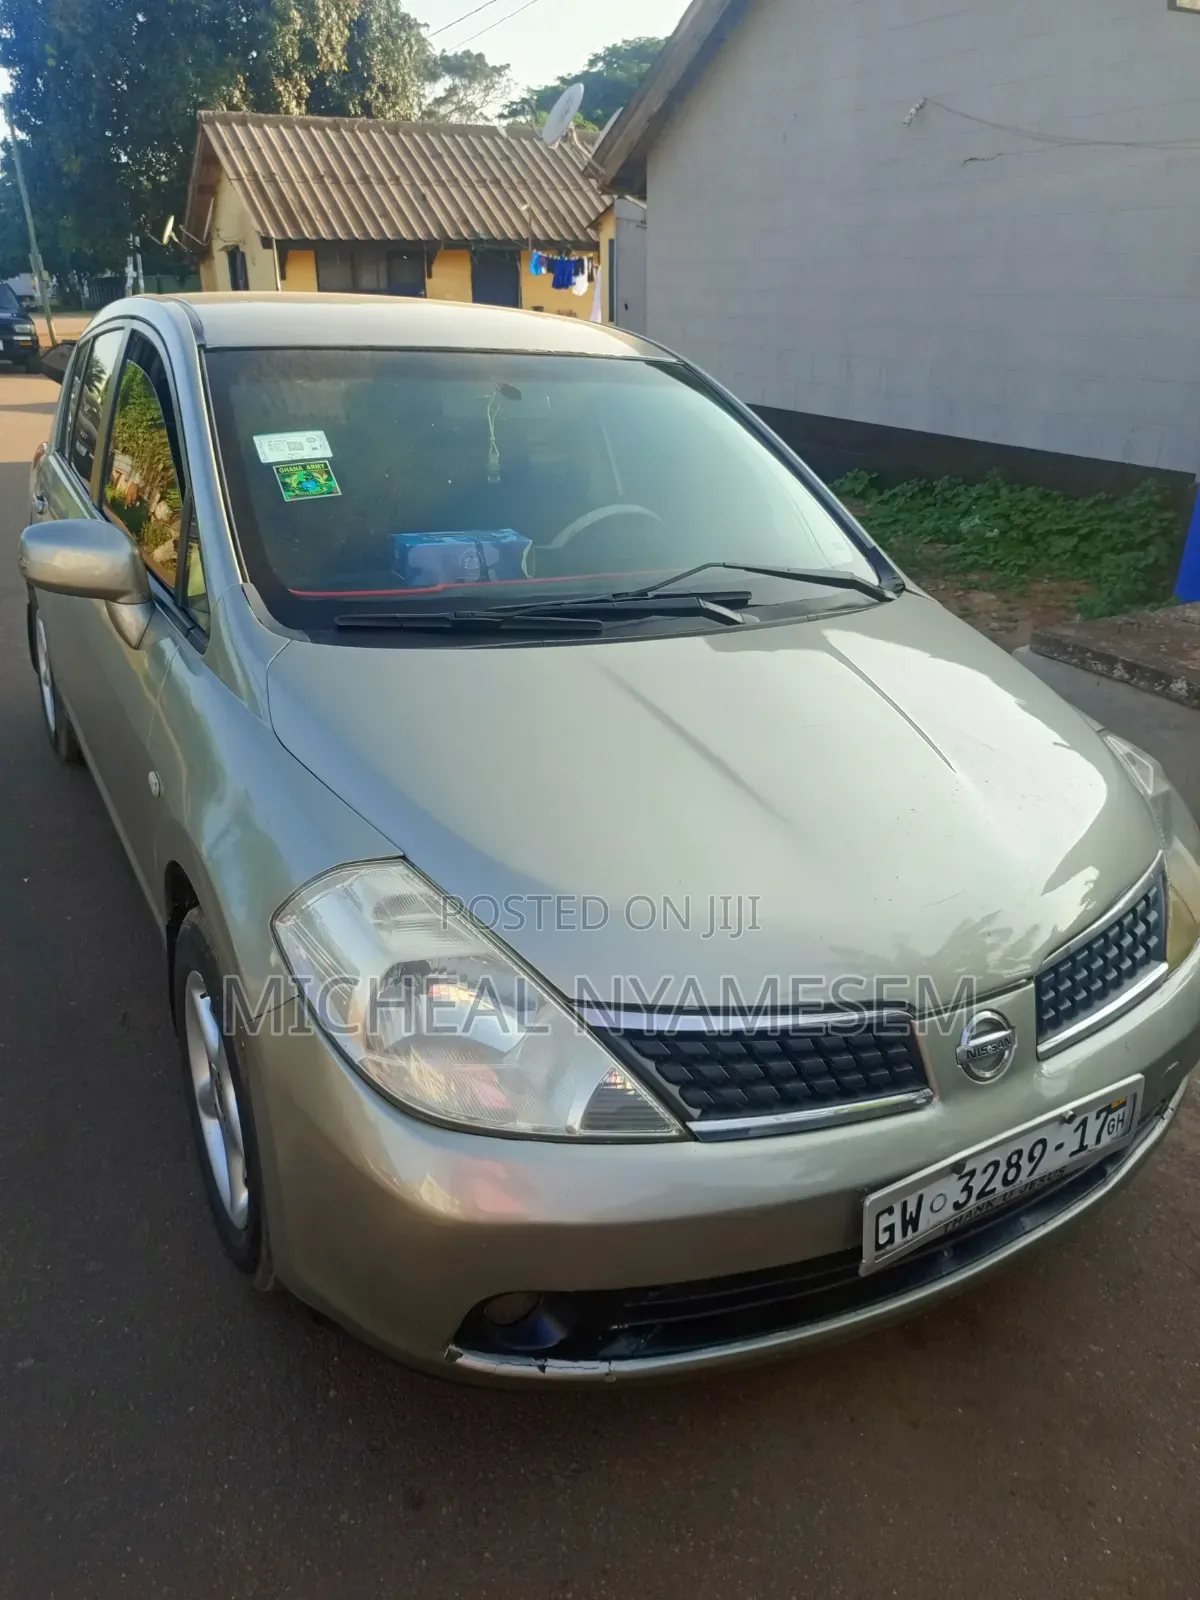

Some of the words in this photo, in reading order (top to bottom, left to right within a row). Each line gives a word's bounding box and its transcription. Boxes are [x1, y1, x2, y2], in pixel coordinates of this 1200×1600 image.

[279, 465, 304, 474] GHANA
[306, 463, 325, 471] ARMY
[965, 1035, 1012, 1060] NISSAN
[1106, 1110, 1126, 1136] GH
[875, 1193, 923, 1251] GW
[953, 1110, 1111, 1211] 3289-17
